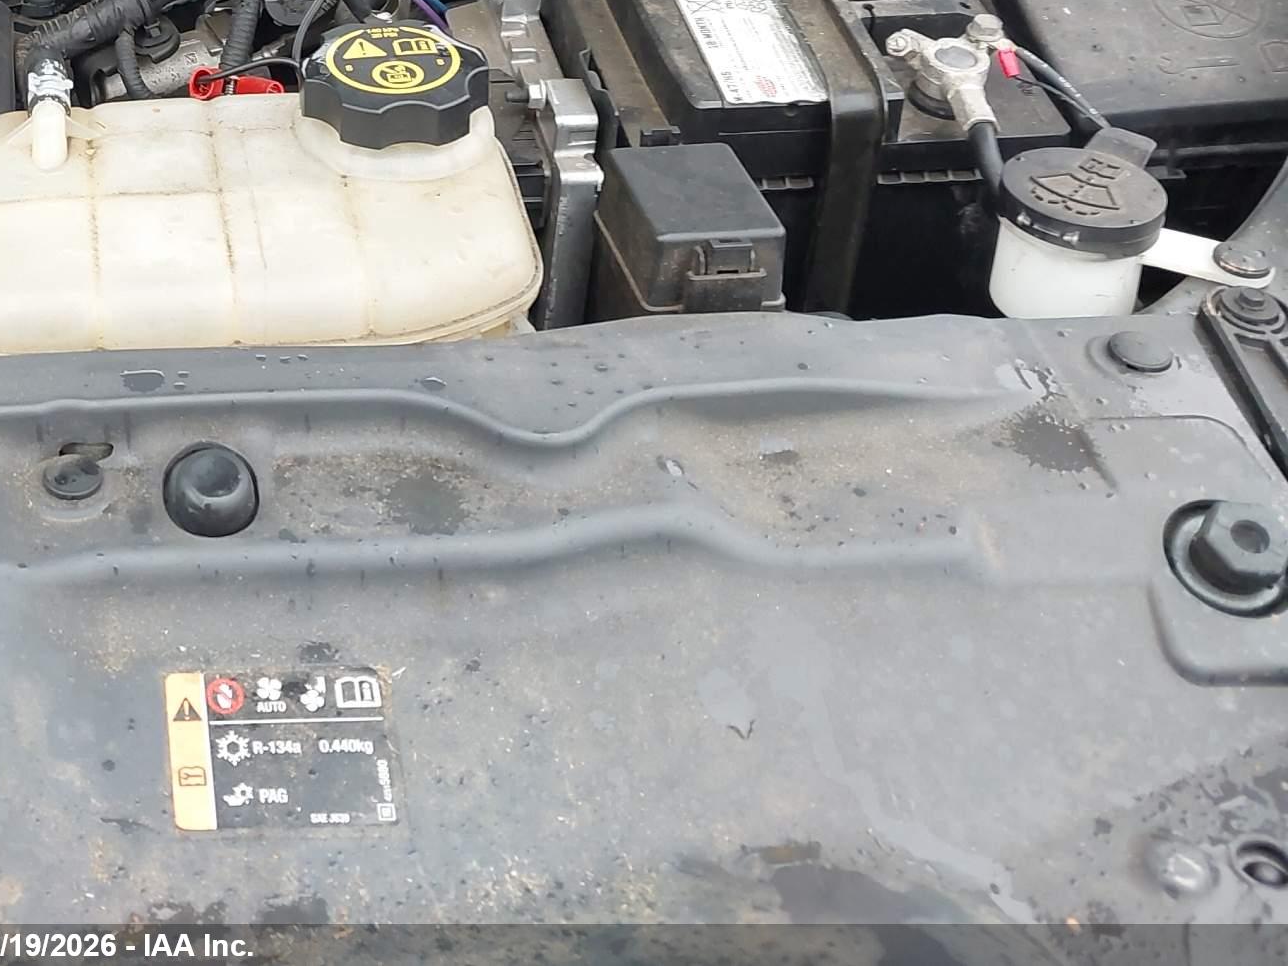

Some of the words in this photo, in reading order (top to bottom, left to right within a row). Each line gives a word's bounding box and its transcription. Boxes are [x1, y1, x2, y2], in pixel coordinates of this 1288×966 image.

[256, 701, 287, 713] AUTO
[252, 740, 302, 755] R-134a
[318, 738, 375, 755] 0.440kg
[258, 787, 289, 804] PAG
